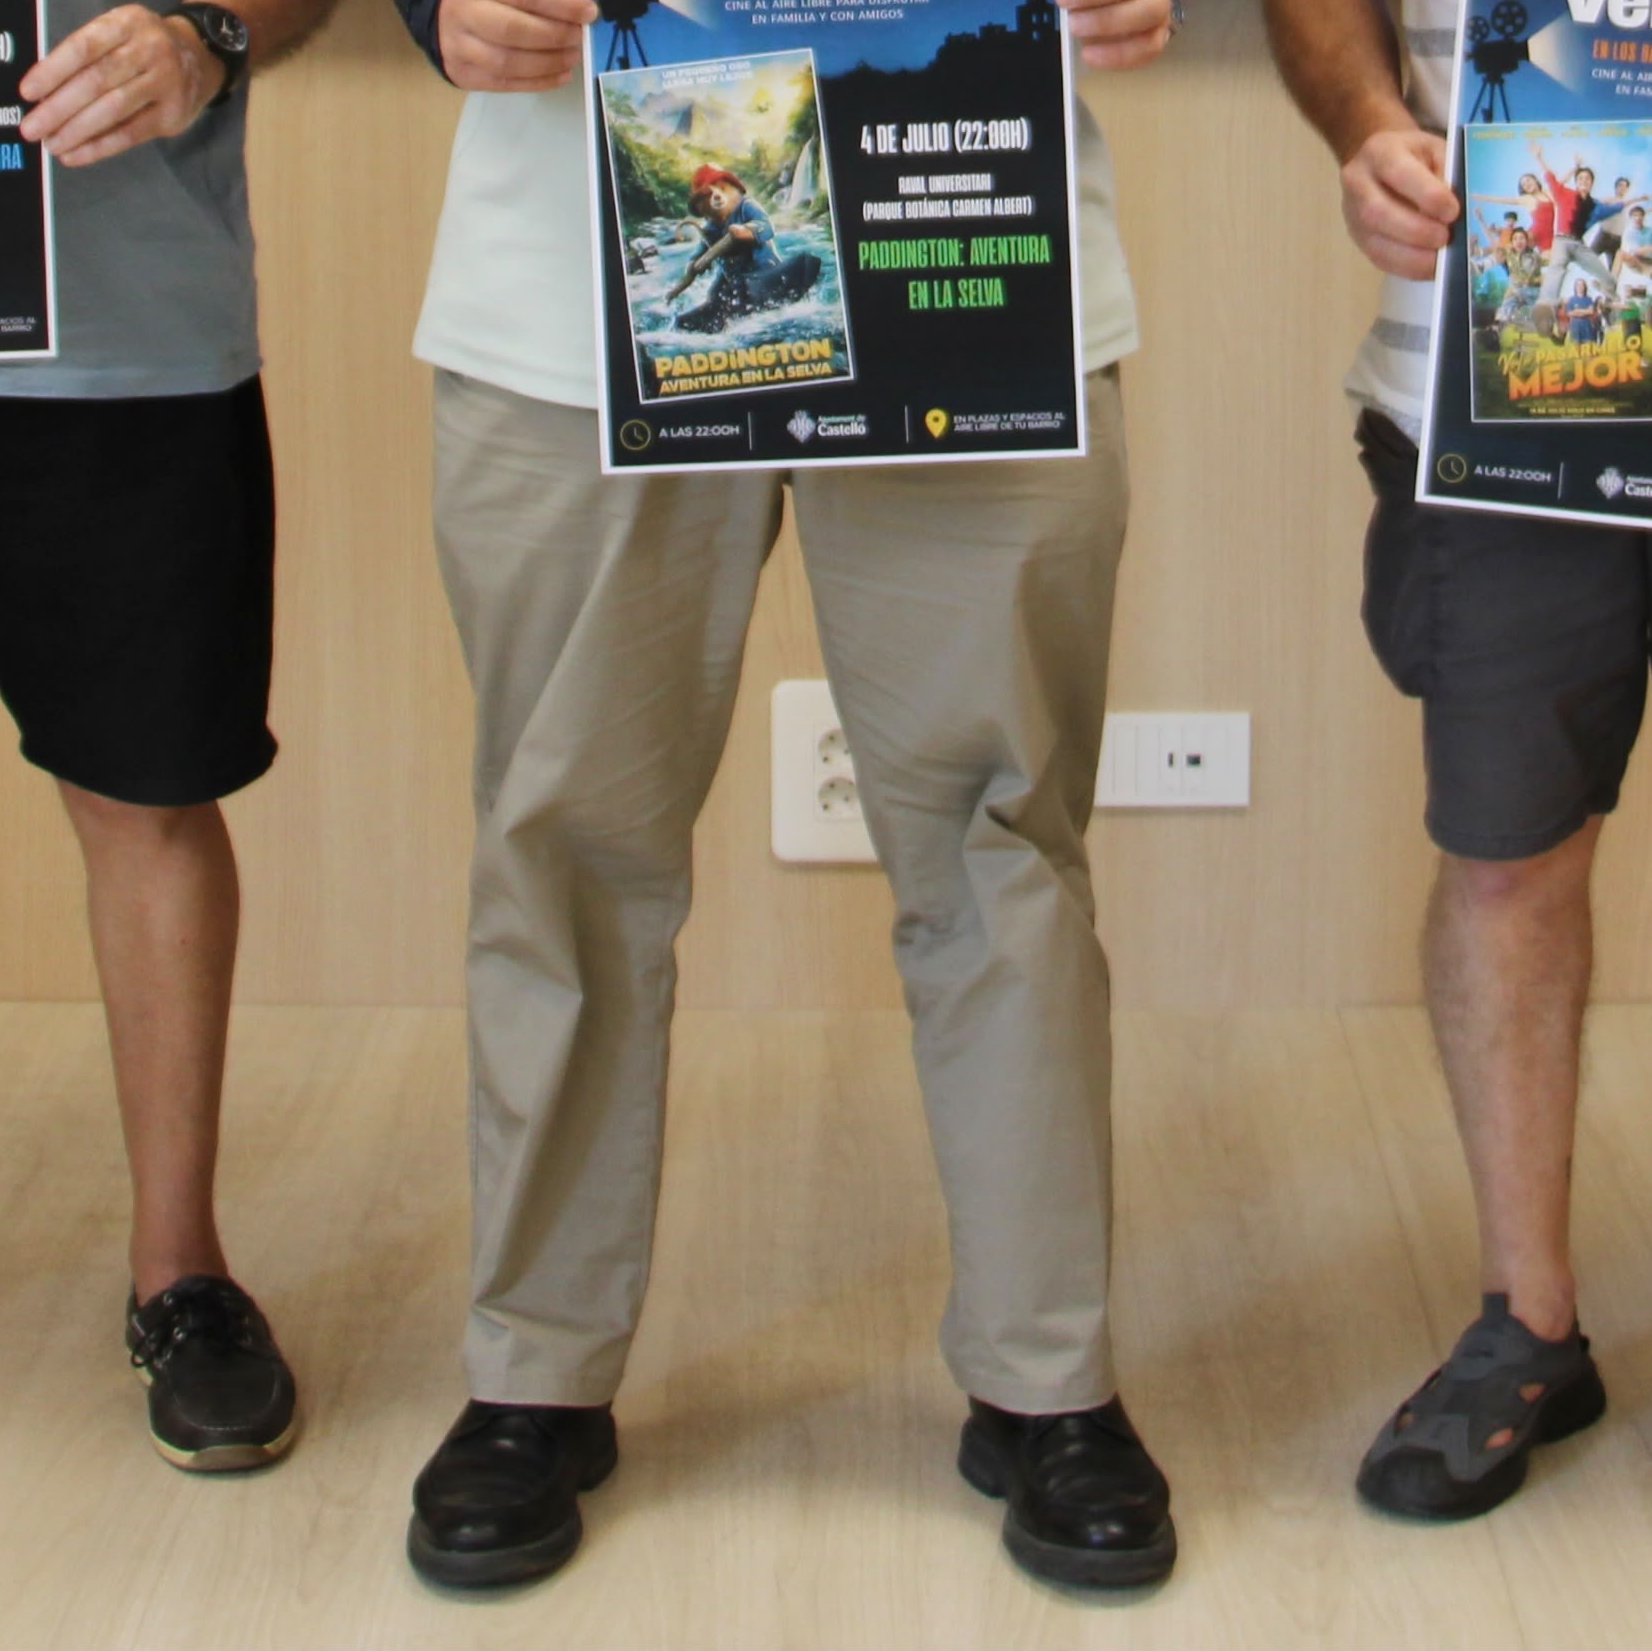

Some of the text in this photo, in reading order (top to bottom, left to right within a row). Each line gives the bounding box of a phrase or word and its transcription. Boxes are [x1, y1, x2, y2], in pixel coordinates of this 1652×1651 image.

[861, 125, 872, 152] 4
[876, 125, 897, 153] DE
[902, 122, 949, 152] JULIO
[898, 174, 991, 194] RAVAL UNIVERSITARI
[863, 196, 1032, 220] (PARQUE BOTÁNICA CARMEN ALBERT)
[858, 235, 1050, 270] PADDINGTON: AVENTURA
[909, 278, 1003, 309] EN LA SELVA
[659, 427, 668, 437] A
[672, 426, 692, 437] LAS
[817, 420, 866, 436] Castelló
